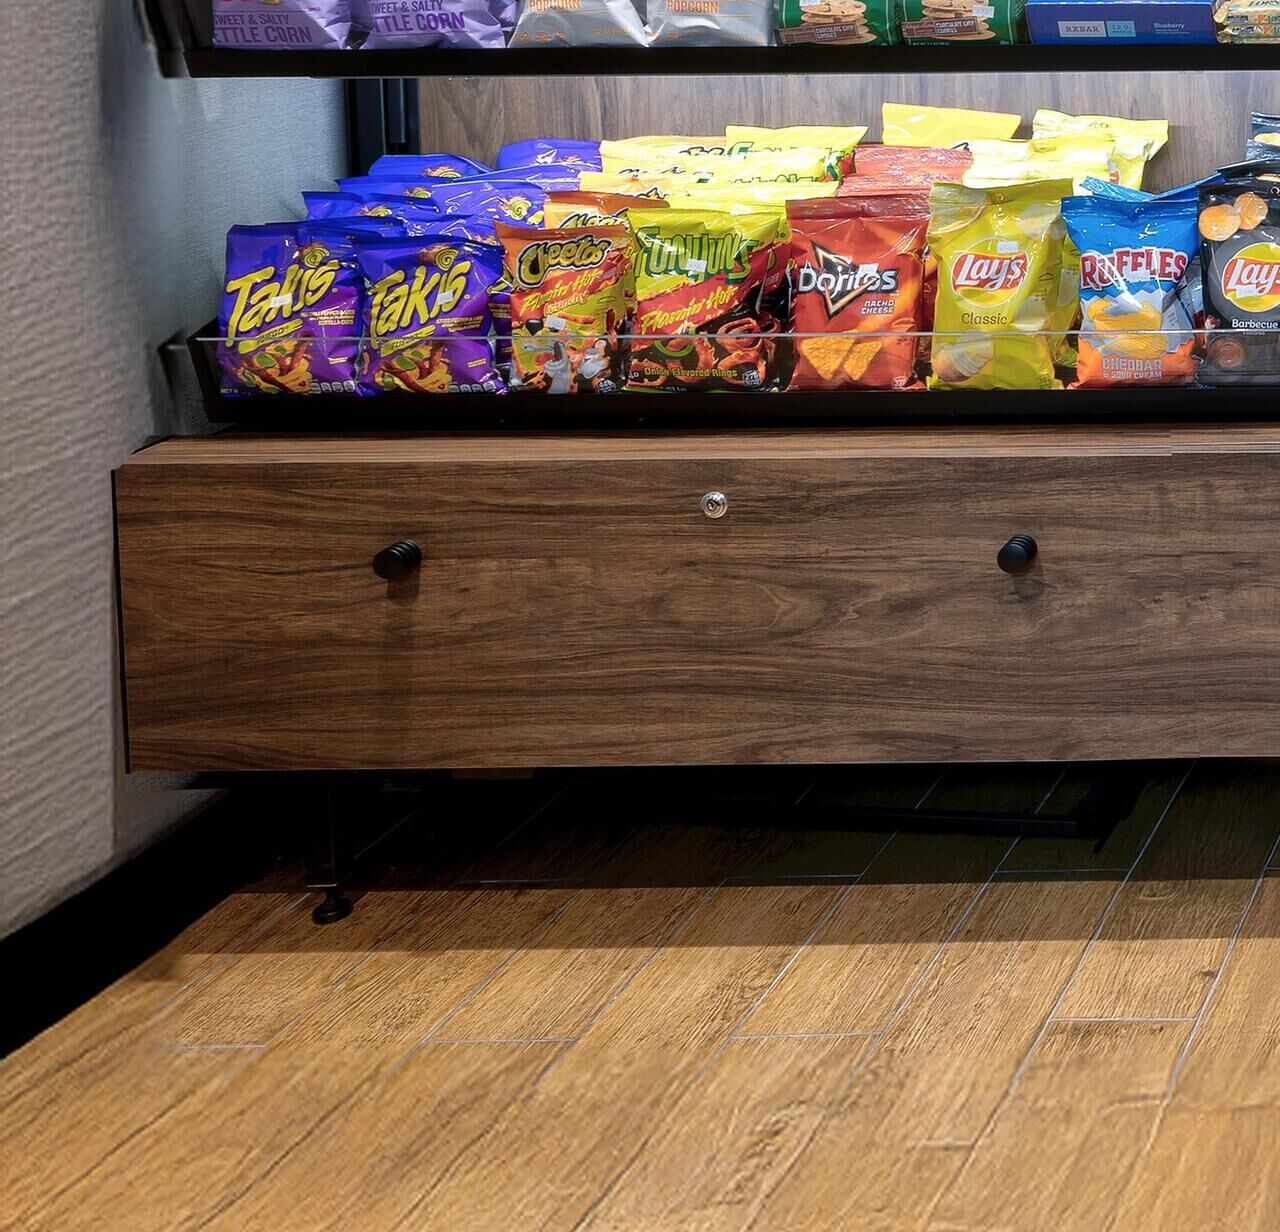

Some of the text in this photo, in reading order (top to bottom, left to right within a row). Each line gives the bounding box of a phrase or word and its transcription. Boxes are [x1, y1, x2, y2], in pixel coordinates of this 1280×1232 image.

[412, 0, 443, 13] SALTY
[529, 0, 580, 12] POPCORN
[667, 0, 719, 14] POPCORN
[417, 13, 466, 31] CORN
[1153, 22, 1185, 30] Blueberry
[264, 27, 313, 44] CORN
[1065, 25, 1100, 33] RXBAR
[518, 235, 610, 288] Cheetos
[955, 254, 1024, 291] Lay's
[1080, 248, 1188, 290] RUFFLES
[799, 262, 898, 294] Doritos
[225, 259, 340, 347] Takis
[860, 306, 895, 314] CHEESE
[961, 312, 1008, 325] Classic
[1231, 319, 1278, 330] Barbecue
[1102, 358, 1162, 371] CHEDDAR
[644, 368, 738, 378] Onion Flavored Rings
[1111, 369, 1162, 380] SOUR CREAM
